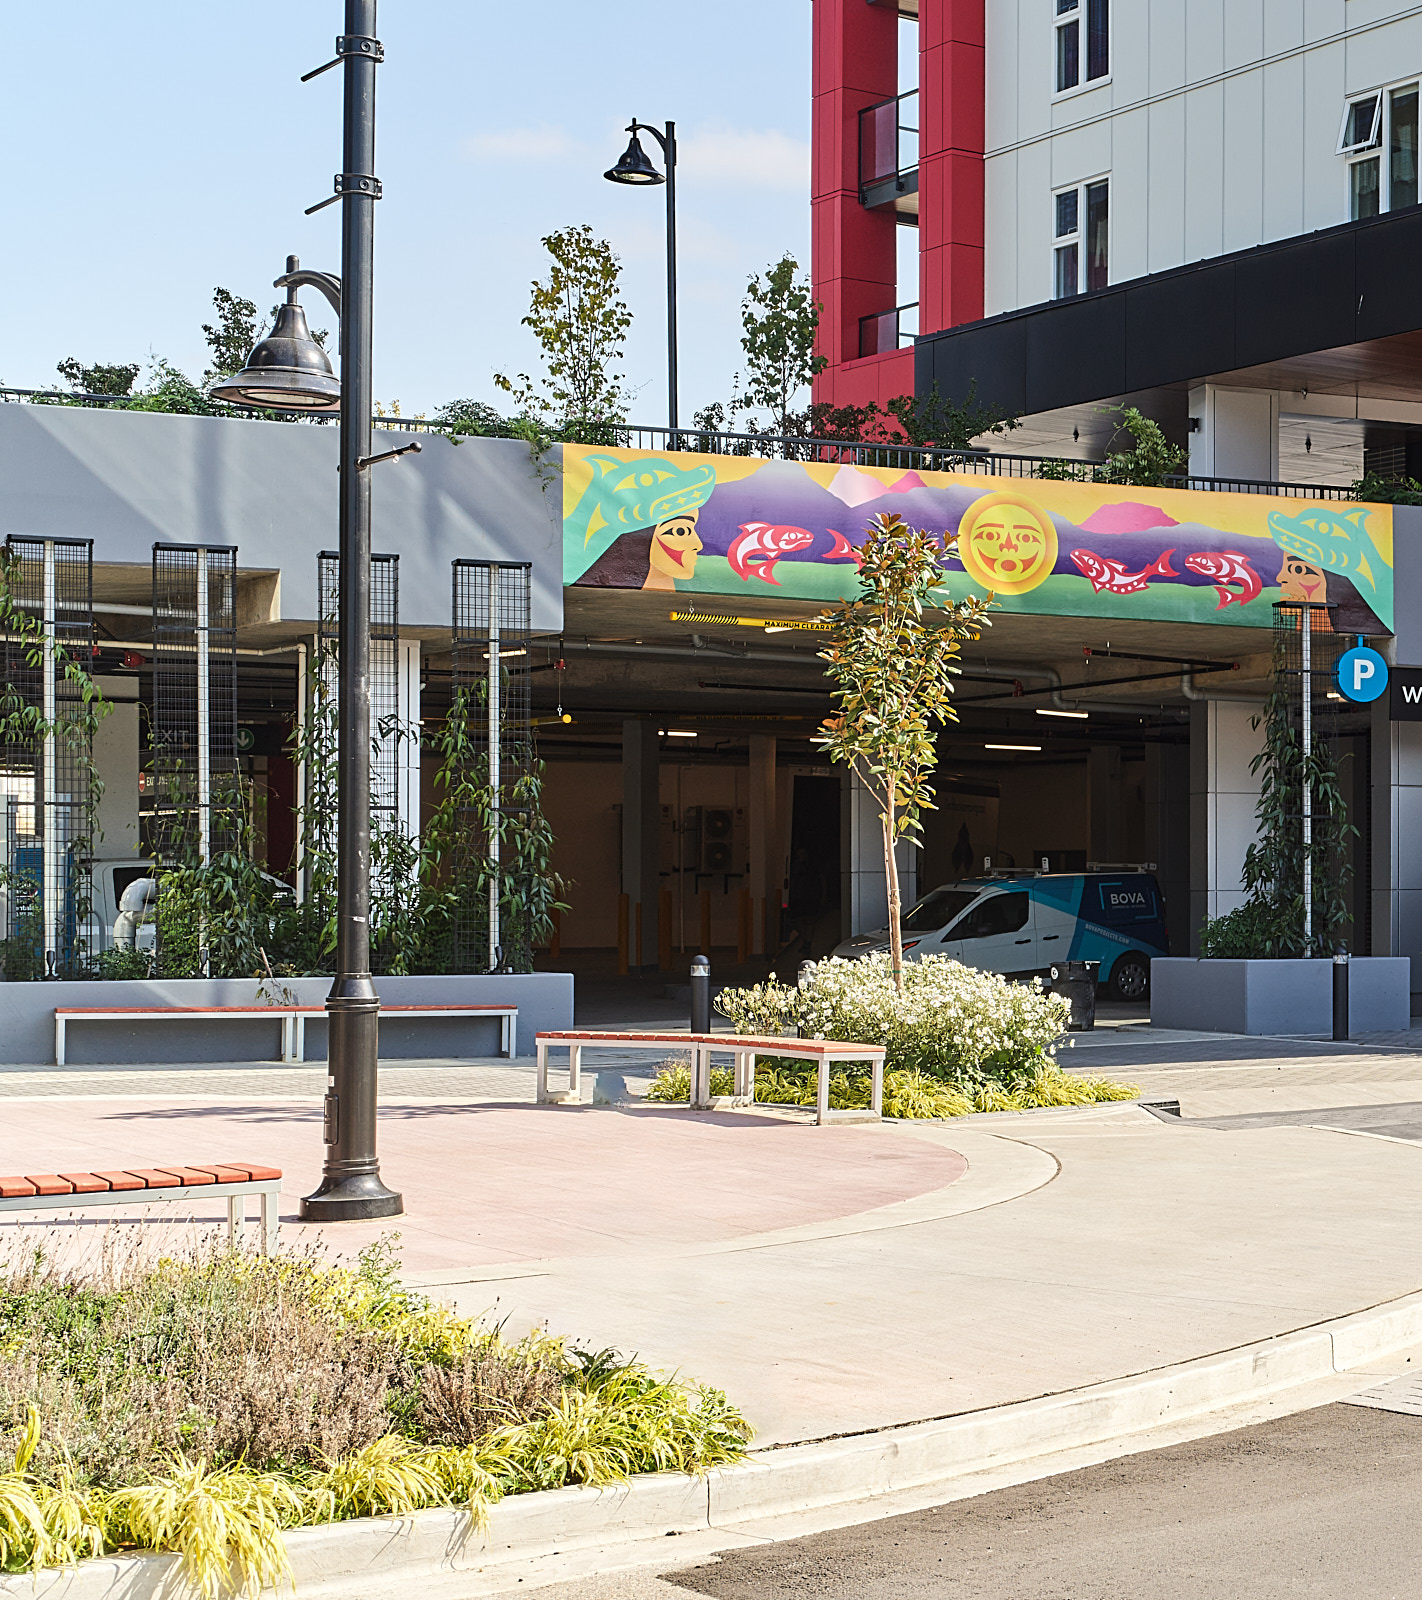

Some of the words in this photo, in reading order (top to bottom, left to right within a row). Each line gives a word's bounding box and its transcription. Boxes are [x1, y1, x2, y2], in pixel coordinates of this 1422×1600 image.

[764, 621, 800, 629] MAXIMUM
[1353, 658, 1375, 690] P
[1110, 892, 1145, 904] BOVA
